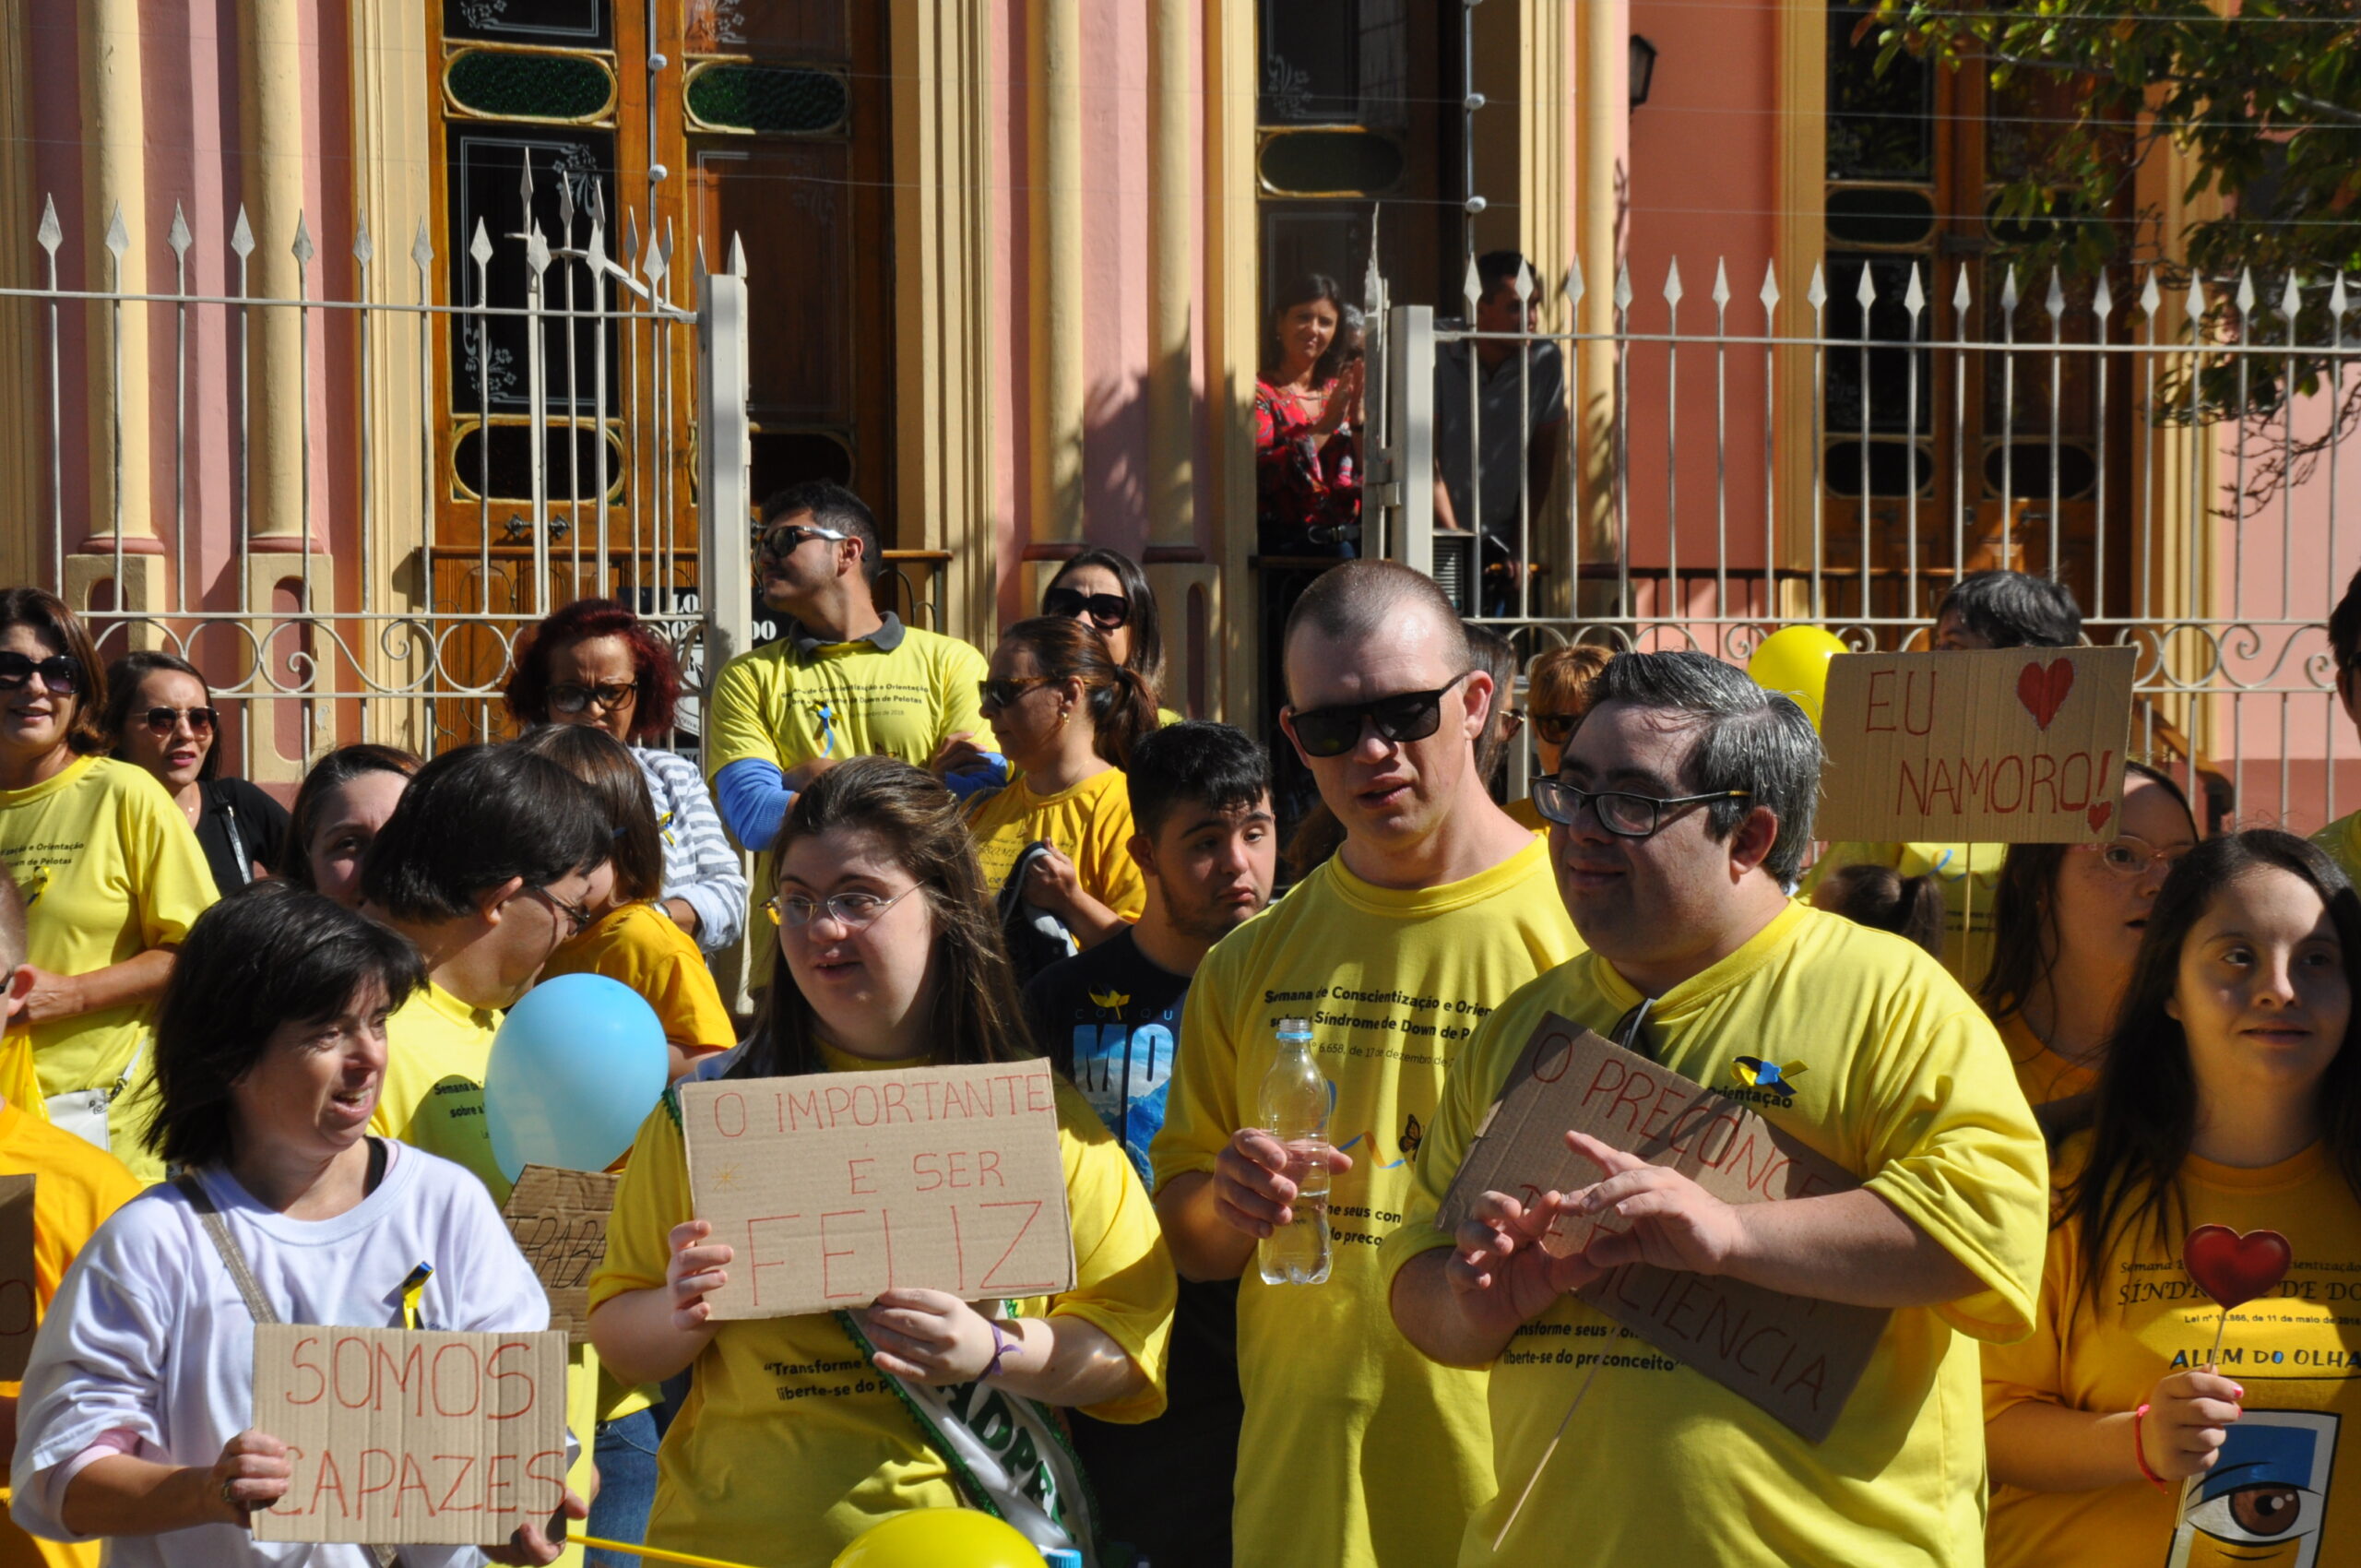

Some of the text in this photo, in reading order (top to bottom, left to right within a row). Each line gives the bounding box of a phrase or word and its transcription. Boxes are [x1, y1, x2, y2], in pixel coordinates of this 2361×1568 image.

[1866, 670, 1937, 735] EU
[1897, 750, 2112, 817] NAMORO!
[40, 857, 72, 866] Pelotas
[1332, 986, 1440, 1012] Conscientização
[1443, 1001, 1453, 1012] e
[1381, 1016, 1396, 1030] de
[1401, 1018, 1437, 1037] Down
[1440, 1025, 1458, 1039] de
[714, 1072, 1058, 1138] O IMPORTANTE
[912, 1149, 1005, 1193] SER
[1343, 1206, 1371, 1218] seus
[746, 1200, 1056, 1307] FELIZ
[1574, 1324, 1607, 1336] seus
[1555, 1348, 1573, 1364] do
[2253, 1349, 2285, 1364] DO
[286, 1336, 536, 1420] SOMOS
[777, 1384, 850, 1401] liberte-se
[855, 1378, 875, 1394] do
